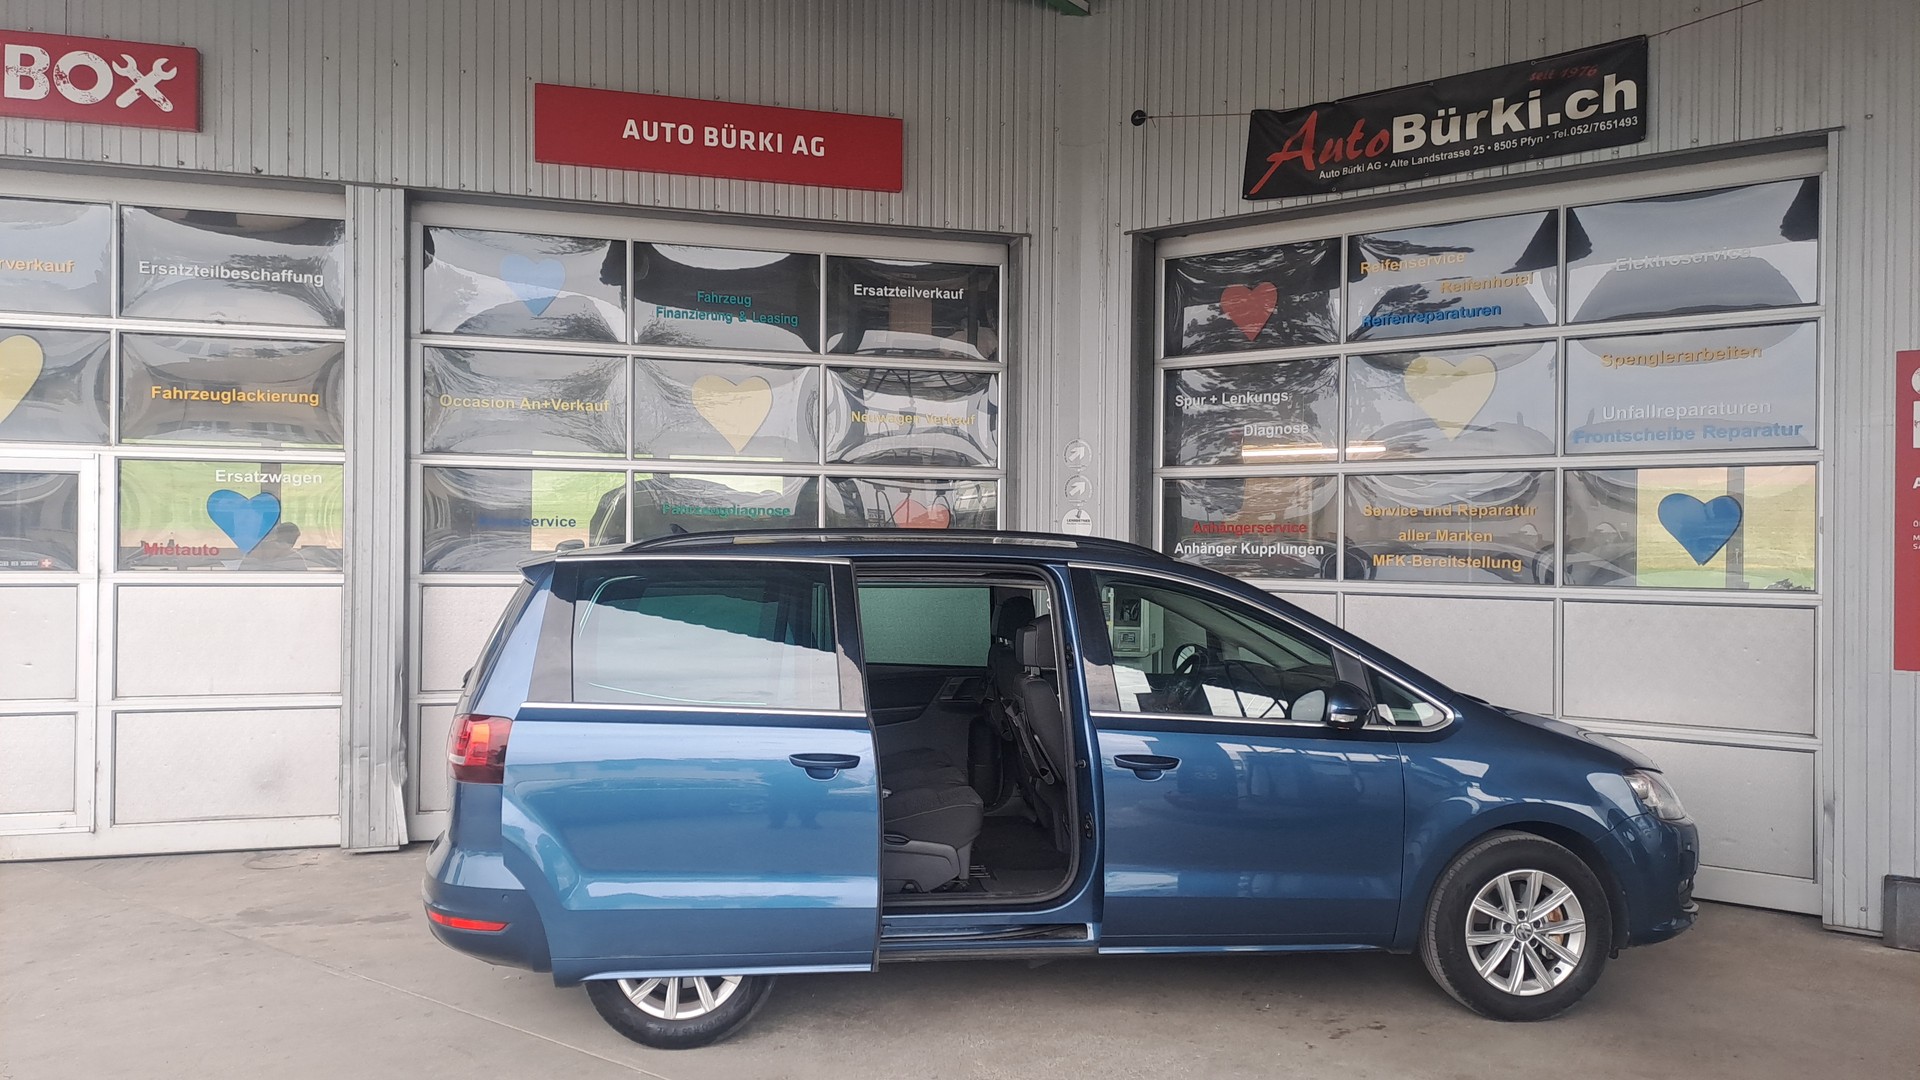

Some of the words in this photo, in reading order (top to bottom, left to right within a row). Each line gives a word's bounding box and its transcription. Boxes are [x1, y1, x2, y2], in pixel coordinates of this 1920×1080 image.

[1560, 65, 1598, 78] 1976
[622, 118, 694, 145] AUTO
[704, 123, 783, 154] BÜRKI
[792, 135, 825, 157] AG
[1319, 169, 1340, 180] Auto
[1342, 164, 1365, 176] Bürki
[1366, 161, 1382, 171] AG
[1389, 159, 1409, 169] Alte
[1411, 149, 1471, 166] Landstrasse
[1473, 145, 1485, 155] 25
[1493, 139, 1518, 152] 8505
[1520, 135, 1543, 147] Pfyn
[1360, 251, 1465, 274] Reifenservice
[1616, 247, 1751, 272] Elektroservice
[139, 260, 324, 288] Ersatzteilbeschaffung
[697, 290, 752, 308] Fahrzeug
[853, 284, 964, 300] Ersatzteilverkauf
[656, 306, 733, 325] Finanzierung
[738, 311, 747, 322] &
[752, 311, 799, 327] Leasing
[1362, 304, 1502, 328] Reifenreparaturen
[1601, 345, 1762, 369] Spenglerarbeiten
[151, 386, 319, 407] Fahrzeuglackierung
[439, 394, 515, 408] Occasion
[519, 397, 610, 412] An+Verkauf
[1175, 394, 1206, 409] Spur
[1210, 396, 1218, 404] +
[1222, 391, 1289, 406] Lenkungs
[851, 411, 920, 425] Neuwagen
[926, 414, 976, 425] Verkauf
[1602, 401, 1771, 421] Unfallreparaturen
[1243, 423, 1309, 439] Diagnose
[1573, 426, 1695, 444] Frontscheibe
[1703, 422, 1804, 441] Reparatur
[215, 469, 323, 487] Ersatzwagen
[1362, 504, 1419, 517] Service
[1422, 504, 1452, 517] und
[1457, 504, 1538, 520] Reparatur
[1192, 521, 1307, 536] Anhängerservice
[1398, 529, 1433, 542] aller
[1436, 529, 1493, 542] Marken
[144, 542, 219, 556] Mietauto
[1174, 542, 1237, 557] Anhänger
[1241, 542, 1324, 558] Kupplungen
[1372, 554, 1523, 572] MFK-Bereitstellung
